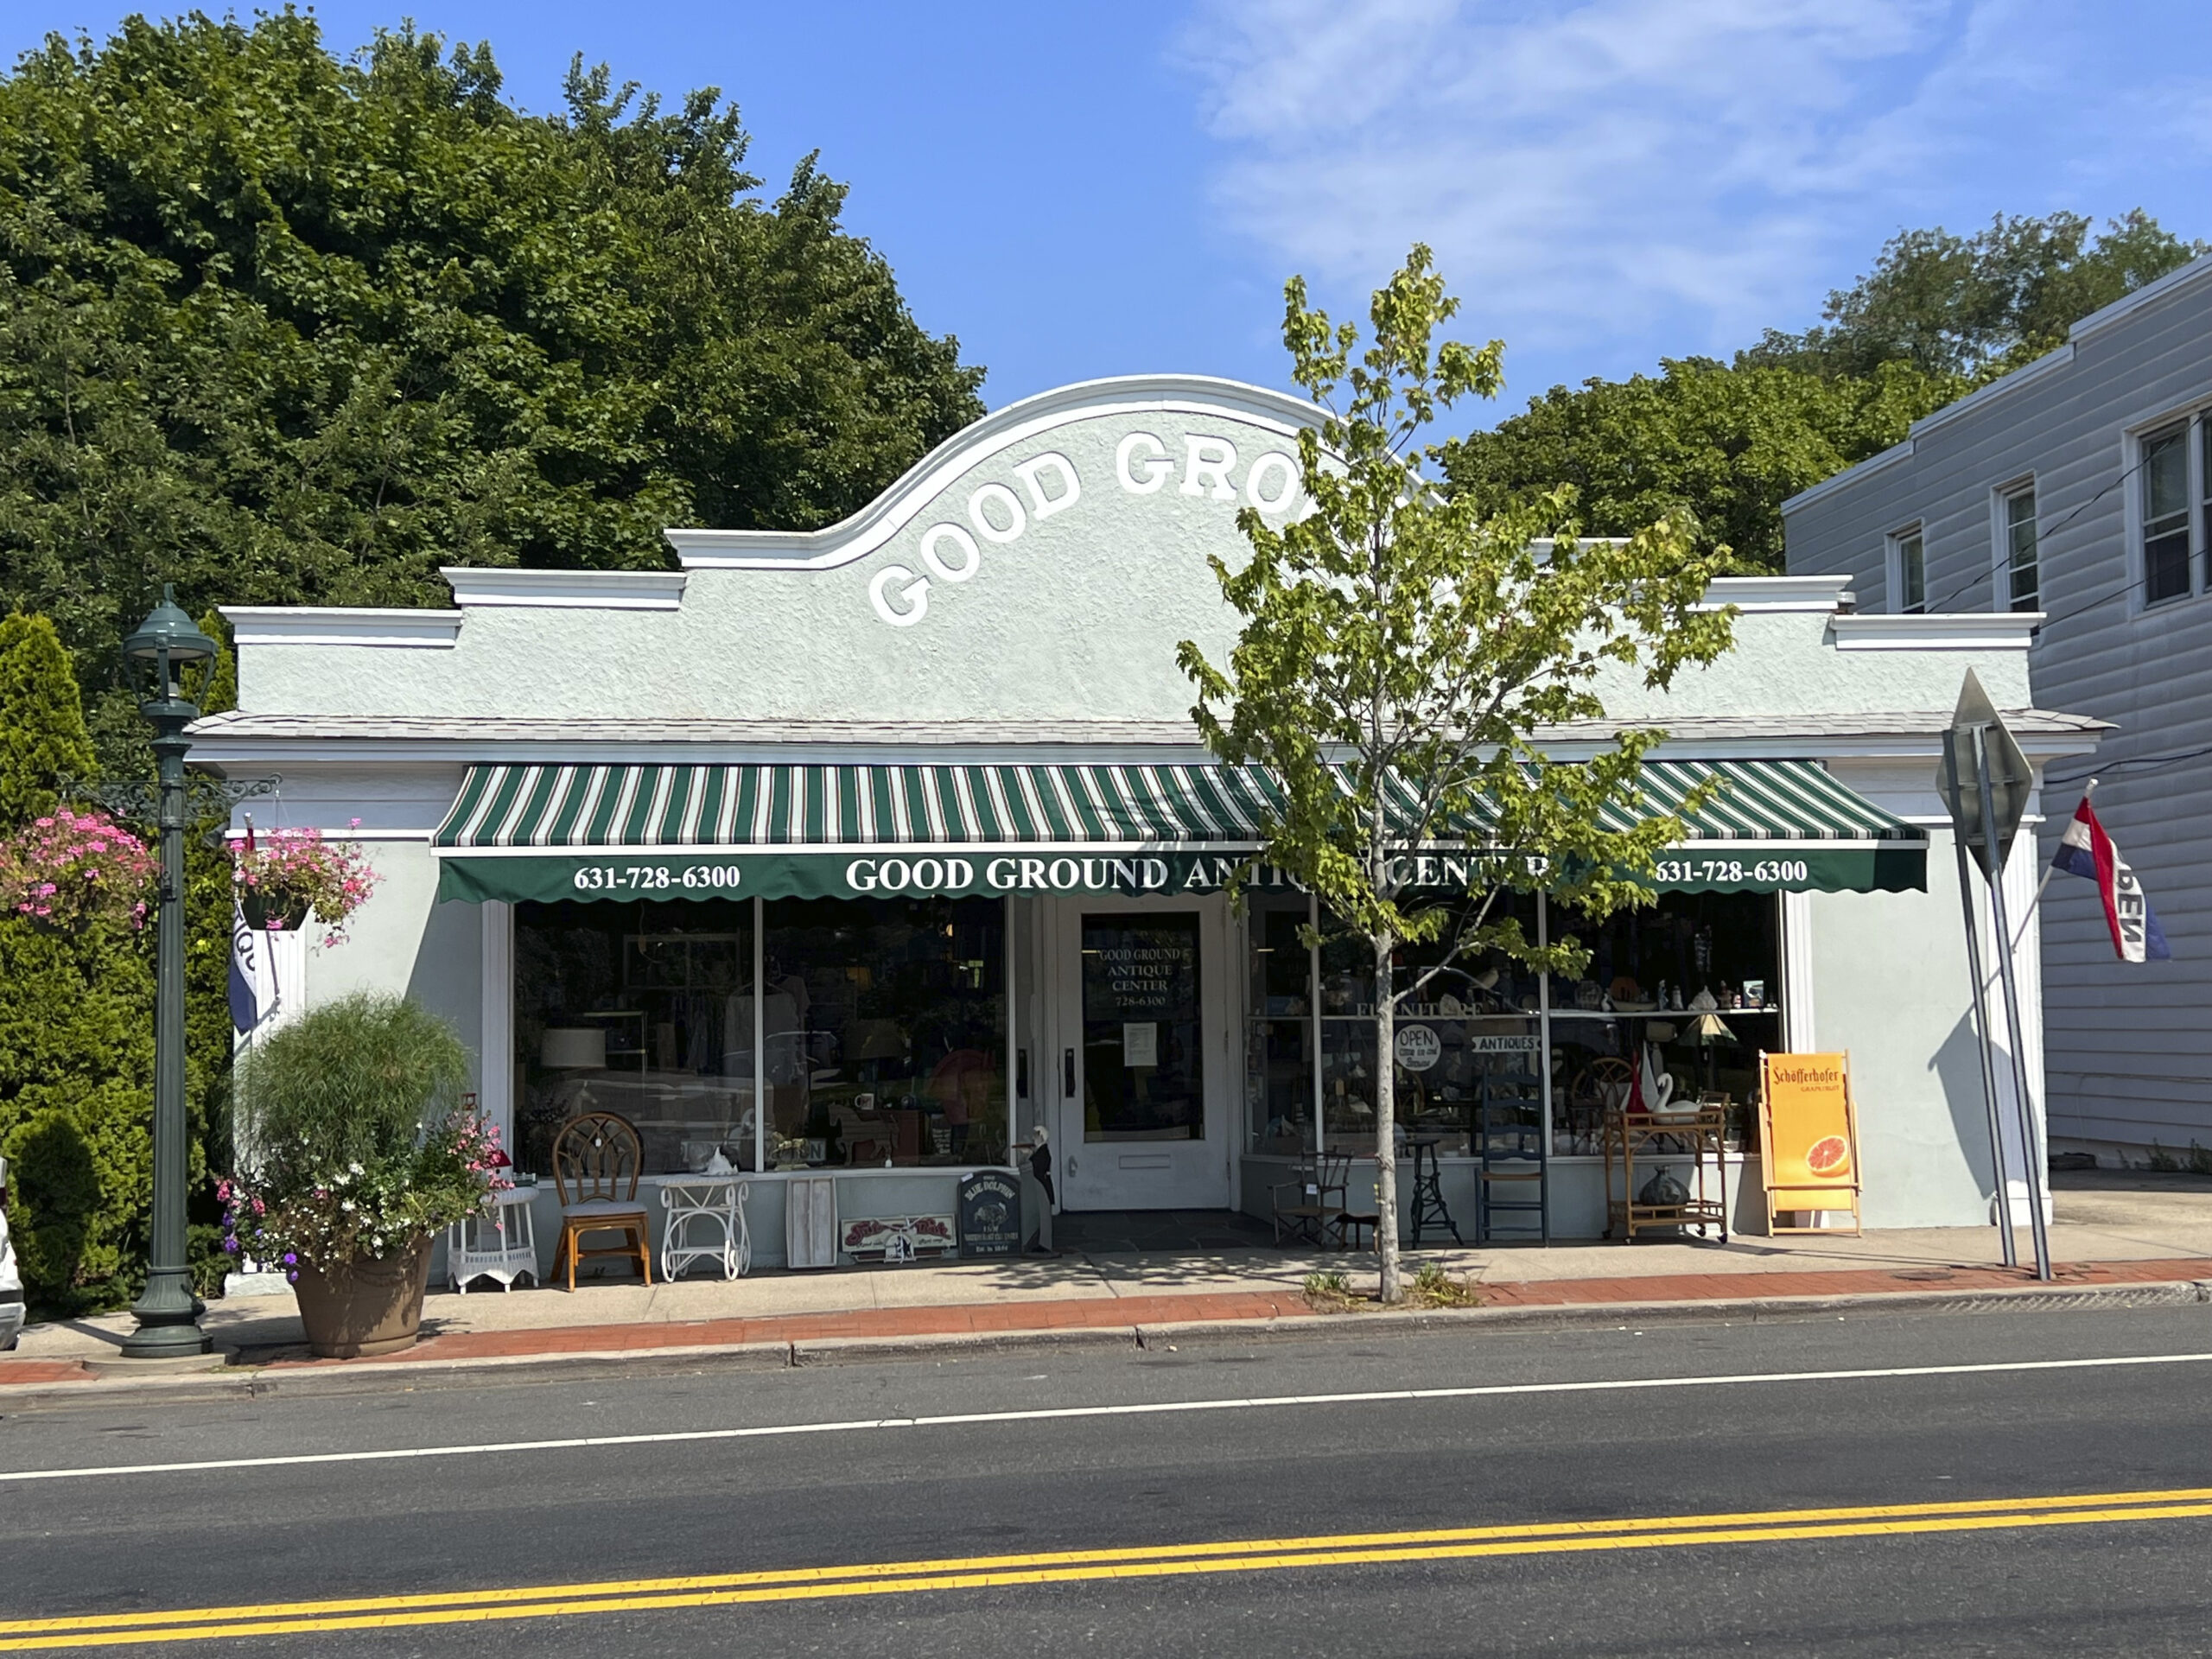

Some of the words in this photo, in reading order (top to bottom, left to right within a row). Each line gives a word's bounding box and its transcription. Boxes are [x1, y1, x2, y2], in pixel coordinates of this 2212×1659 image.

[868, 450, 1083, 627] GOOD
[574, 866, 741, 890] 631-728-6300
[846, 858, 974, 891] GOOD
[986, 857, 1169, 890] GROUND
[1655, 861, 1808, 882] 631-728-6300
[2117, 869, 2143, 943] PEN
[1099, 949, 1131, 961] GOOD
[1134, 948, 1180, 960] GROUND
[1107, 965, 1173, 977] ANTIQUE
[1112, 980, 1168, 992] CENTER
[1115, 996, 1166, 1007] 728-6300
[1400, 1030, 1433, 1046] OPEN
[1478, 1037, 1535, 1050] ANTIQUES
[1773, 1067, 1839, 1085] Schöfferhofer
